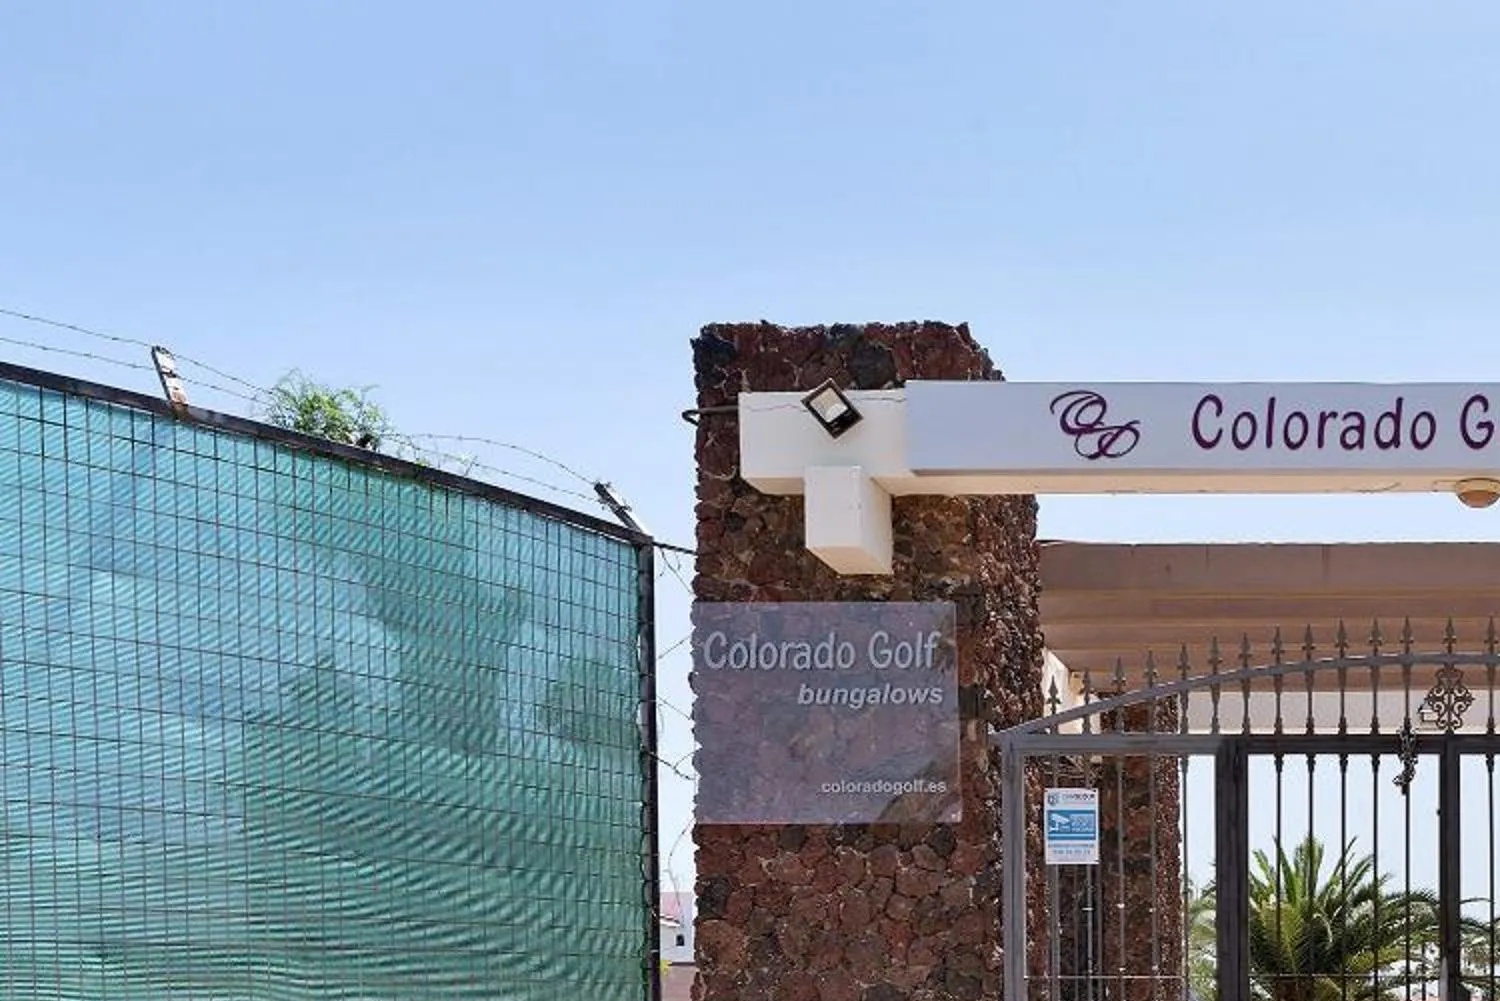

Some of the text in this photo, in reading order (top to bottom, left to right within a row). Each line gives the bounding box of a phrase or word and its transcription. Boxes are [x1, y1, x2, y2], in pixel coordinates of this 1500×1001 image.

[1191, 393, 1437, 451] Colorado
[704, 630, 942, 670] Colorado Golf
[797, 683, 943, 709] bungalows
[822, 780, 946, 795] coloradogolf.es
